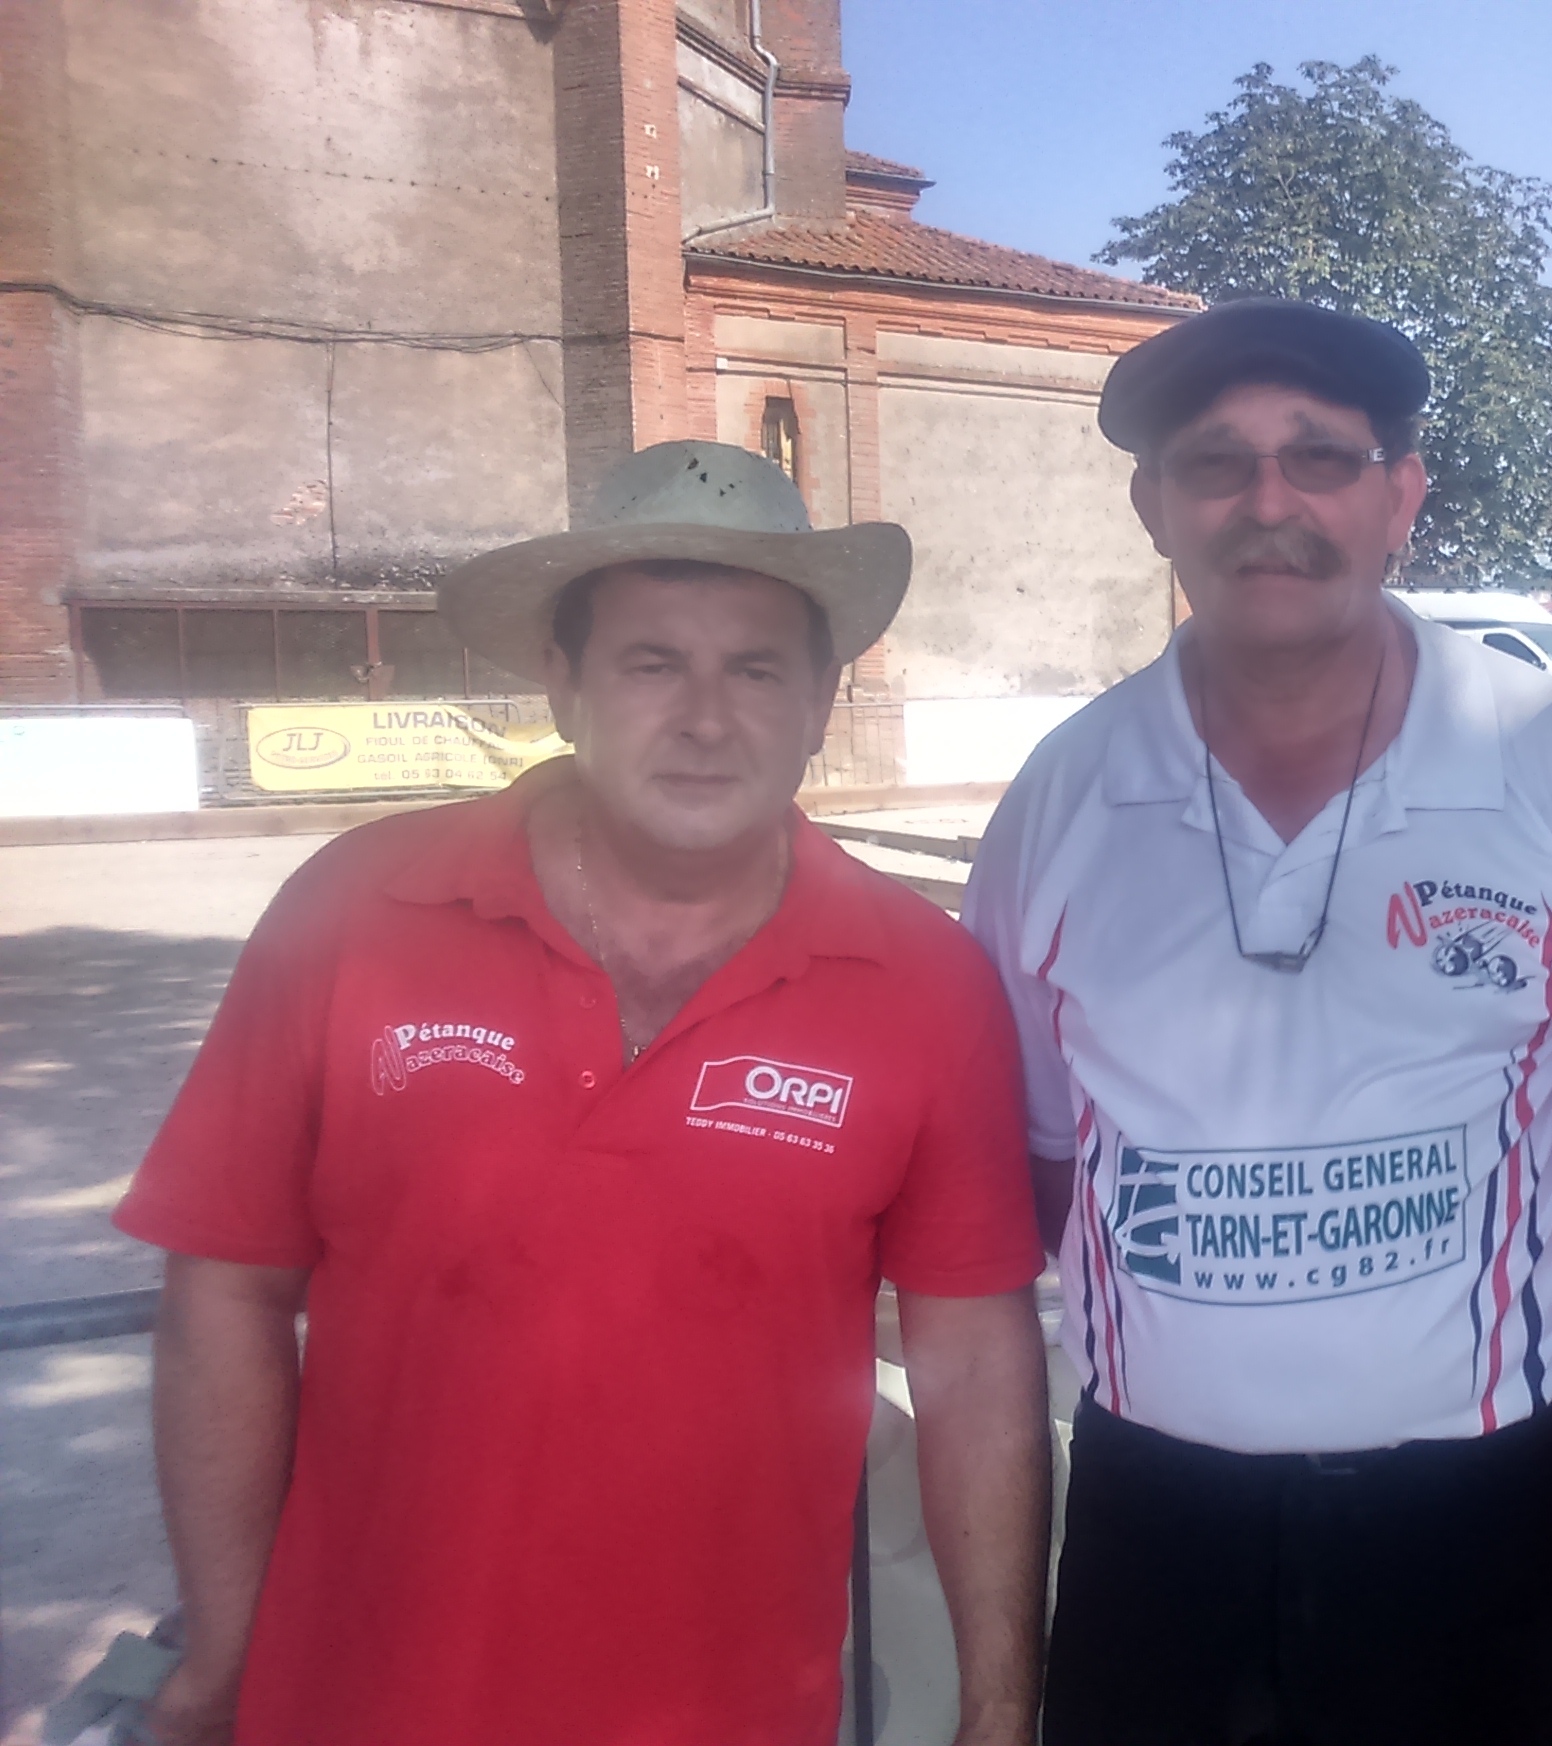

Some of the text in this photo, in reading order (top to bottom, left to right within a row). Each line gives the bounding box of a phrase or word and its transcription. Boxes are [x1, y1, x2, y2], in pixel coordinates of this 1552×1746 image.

[282, 732, 324, 752] JLJ
[357, 754, 408, 764] GASOIL
[415, 752, 477, 764] AGRICOLE
[366, 736, 405, 746] FIOUL
[412, 735, 428, 745] DE
[402, 769, 420, 779] 05
[445, 769, 462, 779] 04
[490, 770, 507, 781] 54
[1386, 880, 1541, 950] Nazeracaise
[1413, 879, 1538, 916] Pétanque
[394, 1023, 516, 1051] Pétanque
[370, 1024, 526, 1097] Nazeracaise
[745, 1065, 844, 1114] ORPI
[685, 1116, 714, 1129] TEDDY
[714, 1119, 767, 1138] IMMOBILIER
[773, 1130, 786, 1142] 05
[786, 1132, 799, 1145] 63
[799, 1135, 812, 1148] 63
[812, 1138, 824, 1151] 35
[823, 1140, 836, 1155] 36
[1186, 1139, 1457, 1200] CONSEIL GENERAL
[1185, 1186, 1461, 1260] TARN-ET-GARONNE
[1194, 1236, 1451, 1291] www.cg82.fr
